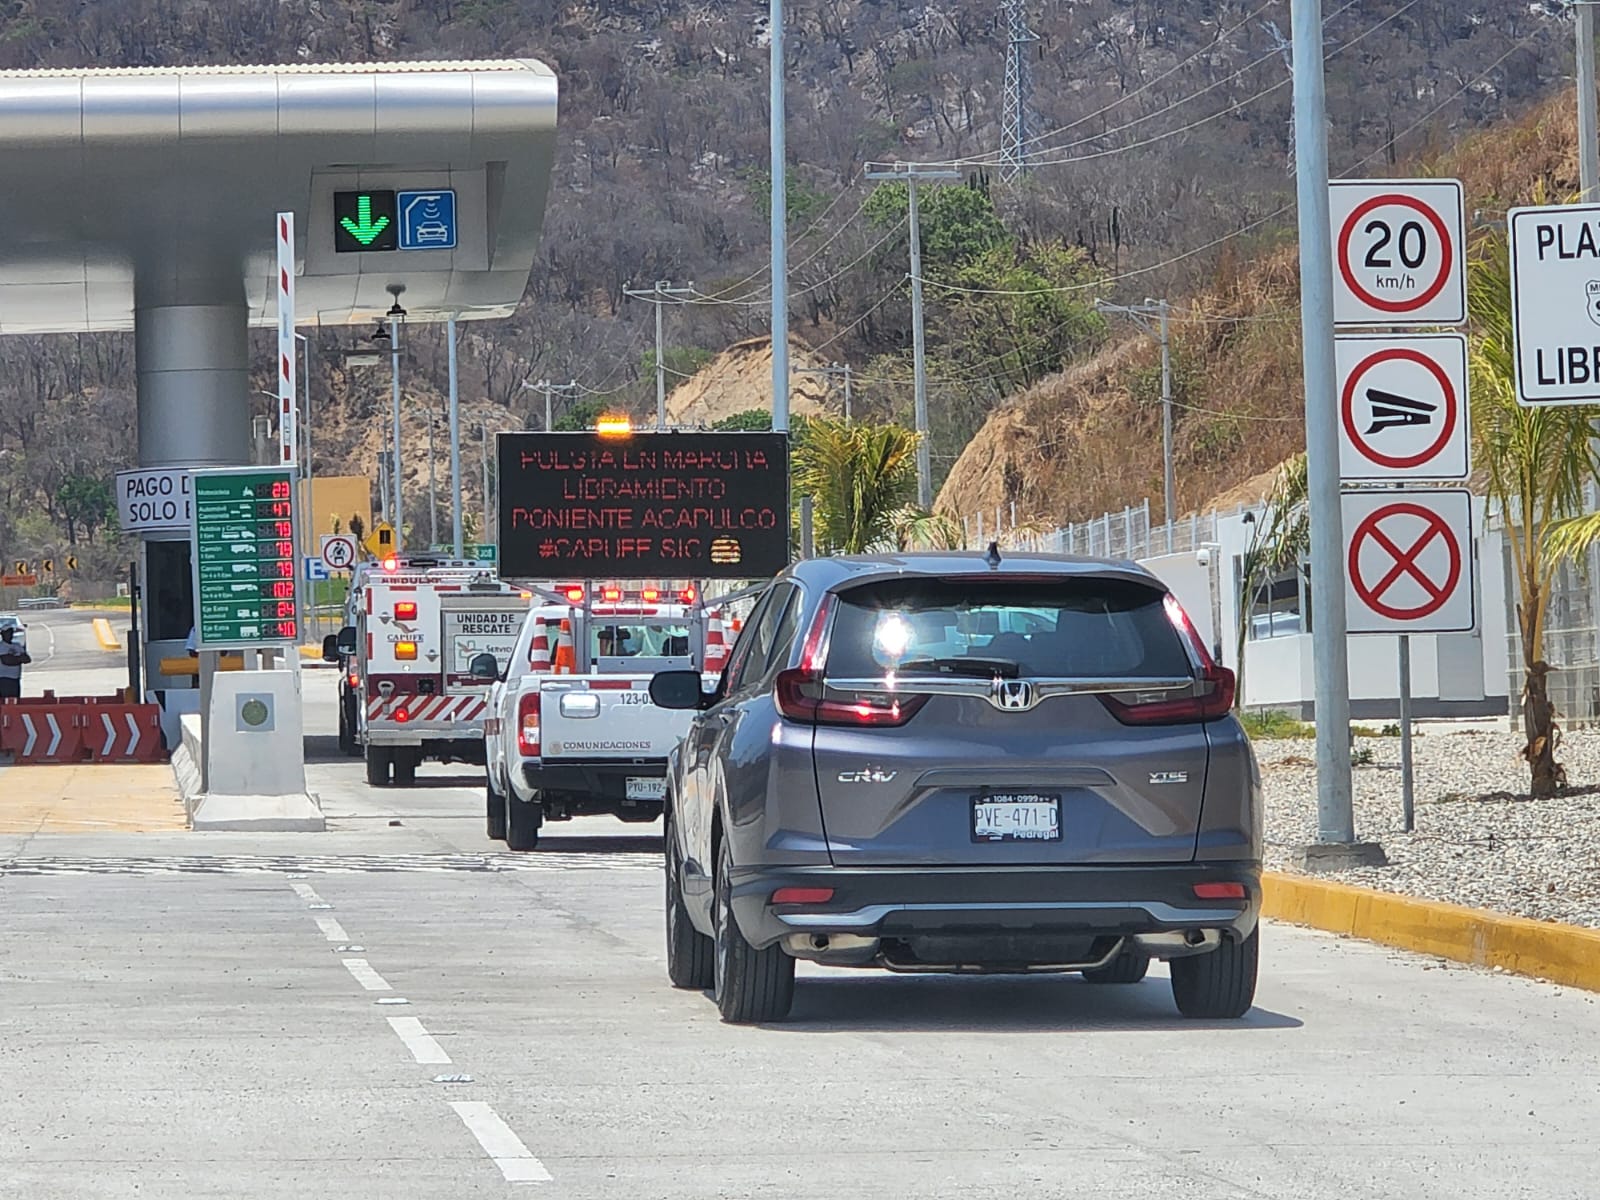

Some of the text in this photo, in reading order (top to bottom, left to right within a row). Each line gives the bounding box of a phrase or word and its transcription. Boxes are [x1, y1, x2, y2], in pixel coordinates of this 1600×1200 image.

[1364, 220, 1427, 269] 20
[1536, 221, 1600, 261] PLA
[1376, 273, 1415, 290] km/h
[127, 476, 173, 498] PAGO
[129, 501, 177, 522] SOLO
[273, 501, 291, 518] 47
[512, 507, 777, 530] PONIENTE ACAPULCO
[273, 582, 294, 598] 102
[277, 601, 295, 617] 24
[456, 614, 515, 623] UNIDAD DE
[278, 620, 296, 637] 40
[462, 624, 512, 633] RESCATE
[620, 692, 654, 705] 123-0
[562, 740, 652, 751] COMUNICACIONES
